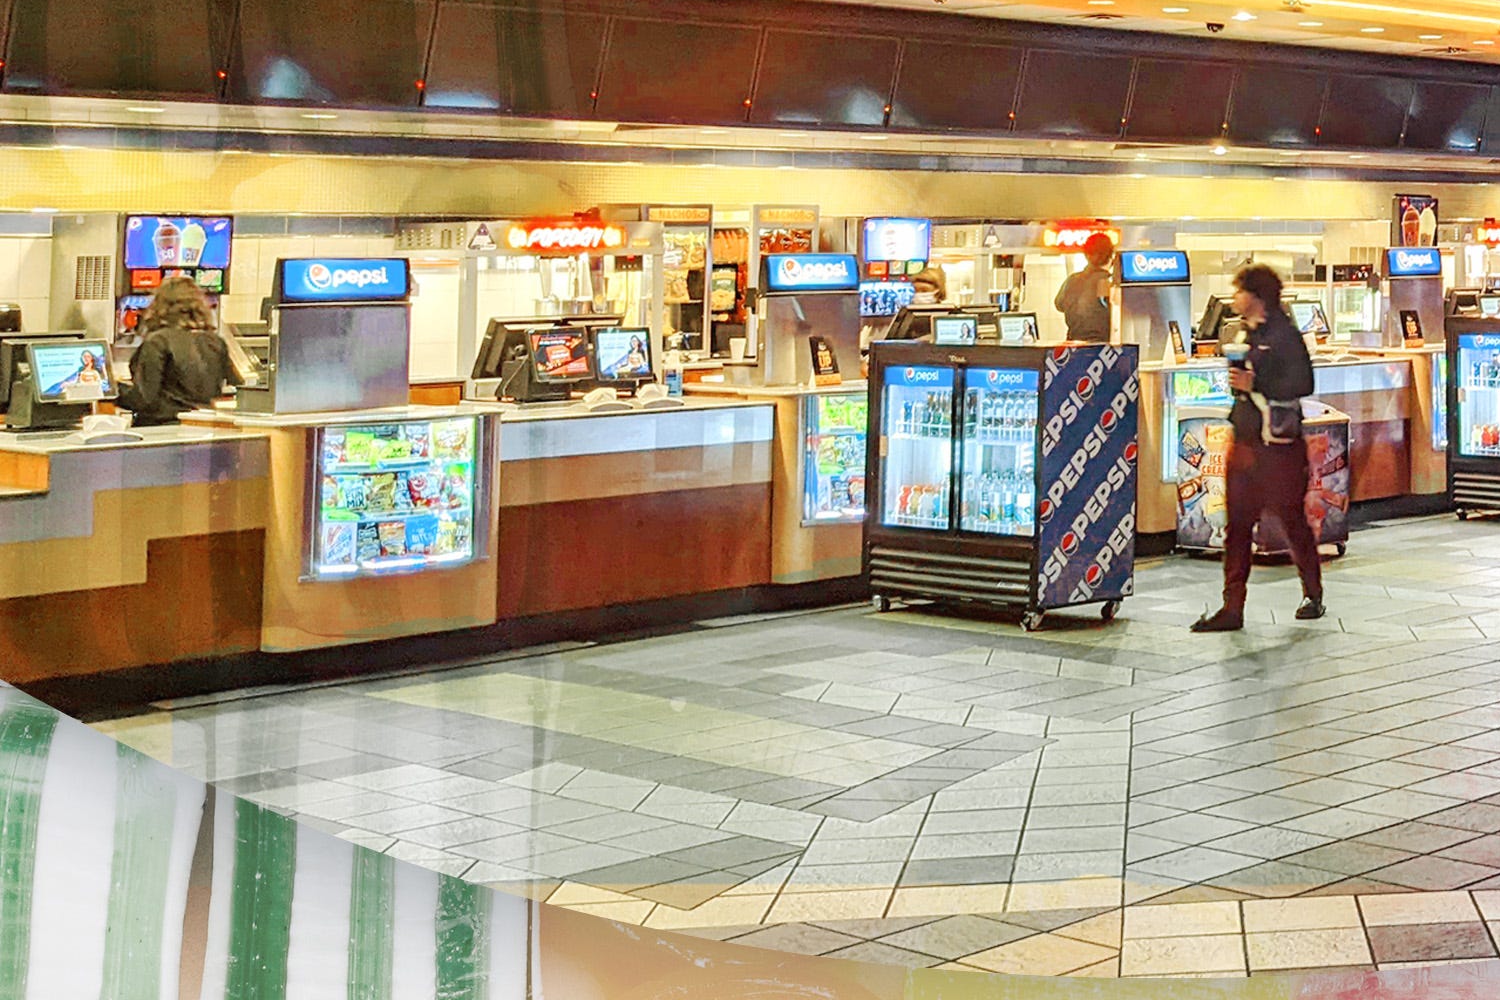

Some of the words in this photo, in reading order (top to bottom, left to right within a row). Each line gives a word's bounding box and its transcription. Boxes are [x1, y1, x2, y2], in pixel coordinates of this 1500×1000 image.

[803, 260, 849, 280] pepsi
[1147, 256, 1178, 272] pepsi
[332, 266, 389, 288] pepsi
[915, 369, 940, 383] pepsi
[999, 371, 1024, 384] pepsi
[1047, 423, 1109, 509] PEPSI
[1071, 456, 1132, 541] PEPSI
